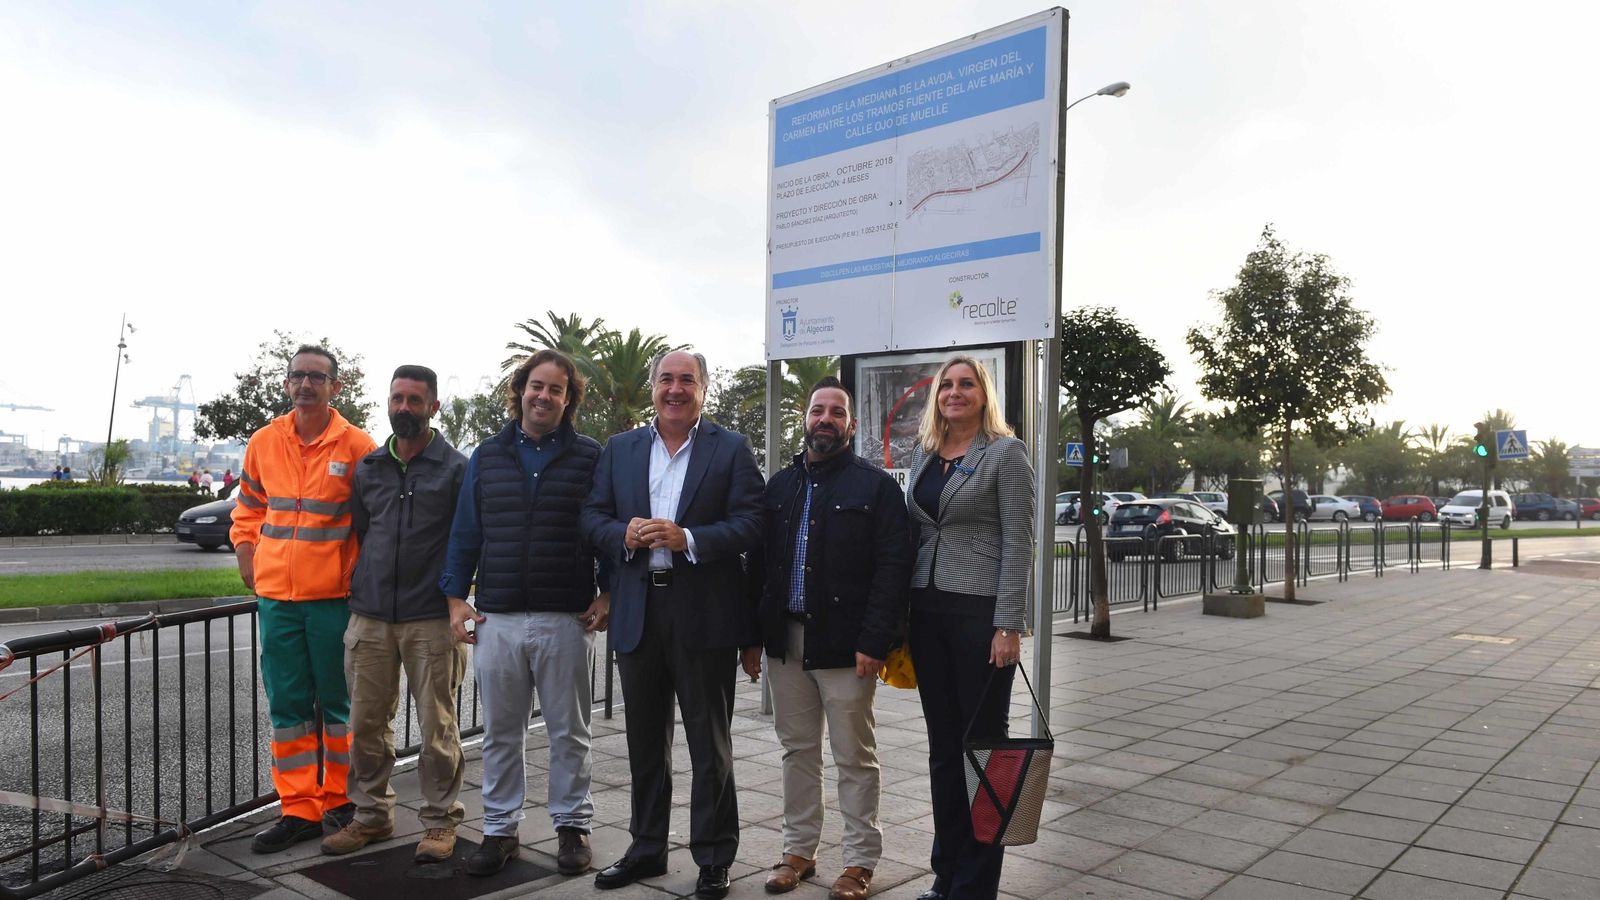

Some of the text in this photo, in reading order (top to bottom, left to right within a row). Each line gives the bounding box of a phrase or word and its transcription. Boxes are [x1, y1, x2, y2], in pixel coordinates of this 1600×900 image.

[791, 109, 830, 126] REFORMA
[832, 104, 843, 115] DE
[845, 101, 856, 112] LA
[856, 88, 898, 109] MEDIANA
[900, 82, 912, 95] DE
[915, 79, 926, 90] LA
[958, 58, 998, 77] VIRGEN
[1001, 51, 1022, 66] DEL
[782, 62, 1034, 142] CARMEN ENTRE LOS TRAMOS FUENTE DEL AVE MARÍA Y
[845, 102, 949, 140] CALLE OJO DE MUELLE
[776, 180, 794, 190] INICIO
[795, 177, 804, 186] DE
[804, 176, 812, 184] LA
[836, 160, 873, 176] OCTUBRE
[875, 156, 893, 167] 2018
[776, 190, 795, 200] PLAZO
[796, 187, 804, 196] DE
[776, 206, 808, 220] PROYECTO
[814, 199, 847, 212] DIRECCIÓN
[848, 196, 857, 205] DE
[859, 192, 879, 203] OBRA:
[776, 222, 791, 230] PABLO
[776, 240, 807, 250] PRESUPUESTO
[935, 249, 969, 261] ALGECIRAS
[949, 272, 989, 283] CONSTRUCTOR
[962, 296, 1017, 319] recolte
[807, 325, 834, 335] Algeciras
